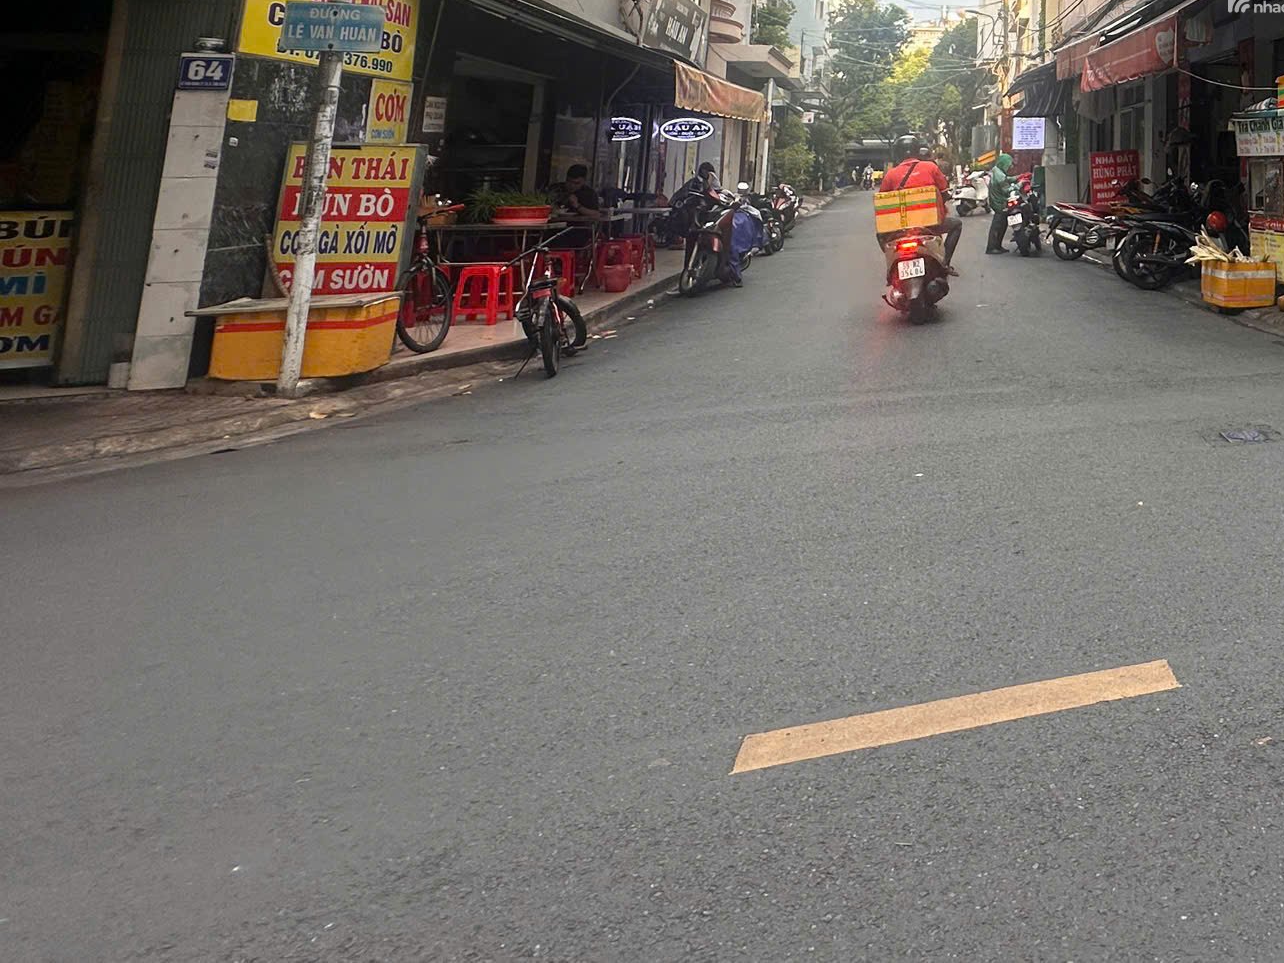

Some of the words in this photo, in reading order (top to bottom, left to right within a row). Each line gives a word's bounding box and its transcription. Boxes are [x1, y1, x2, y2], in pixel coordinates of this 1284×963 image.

[187, 60, 224, 81] 64
[375, 88, 408, 124] CƠM
[351, 151, 410, 181] THÁI
[356, 187, 395, 217] BÒ
[329, 263, 390, 289] SƯỜN
